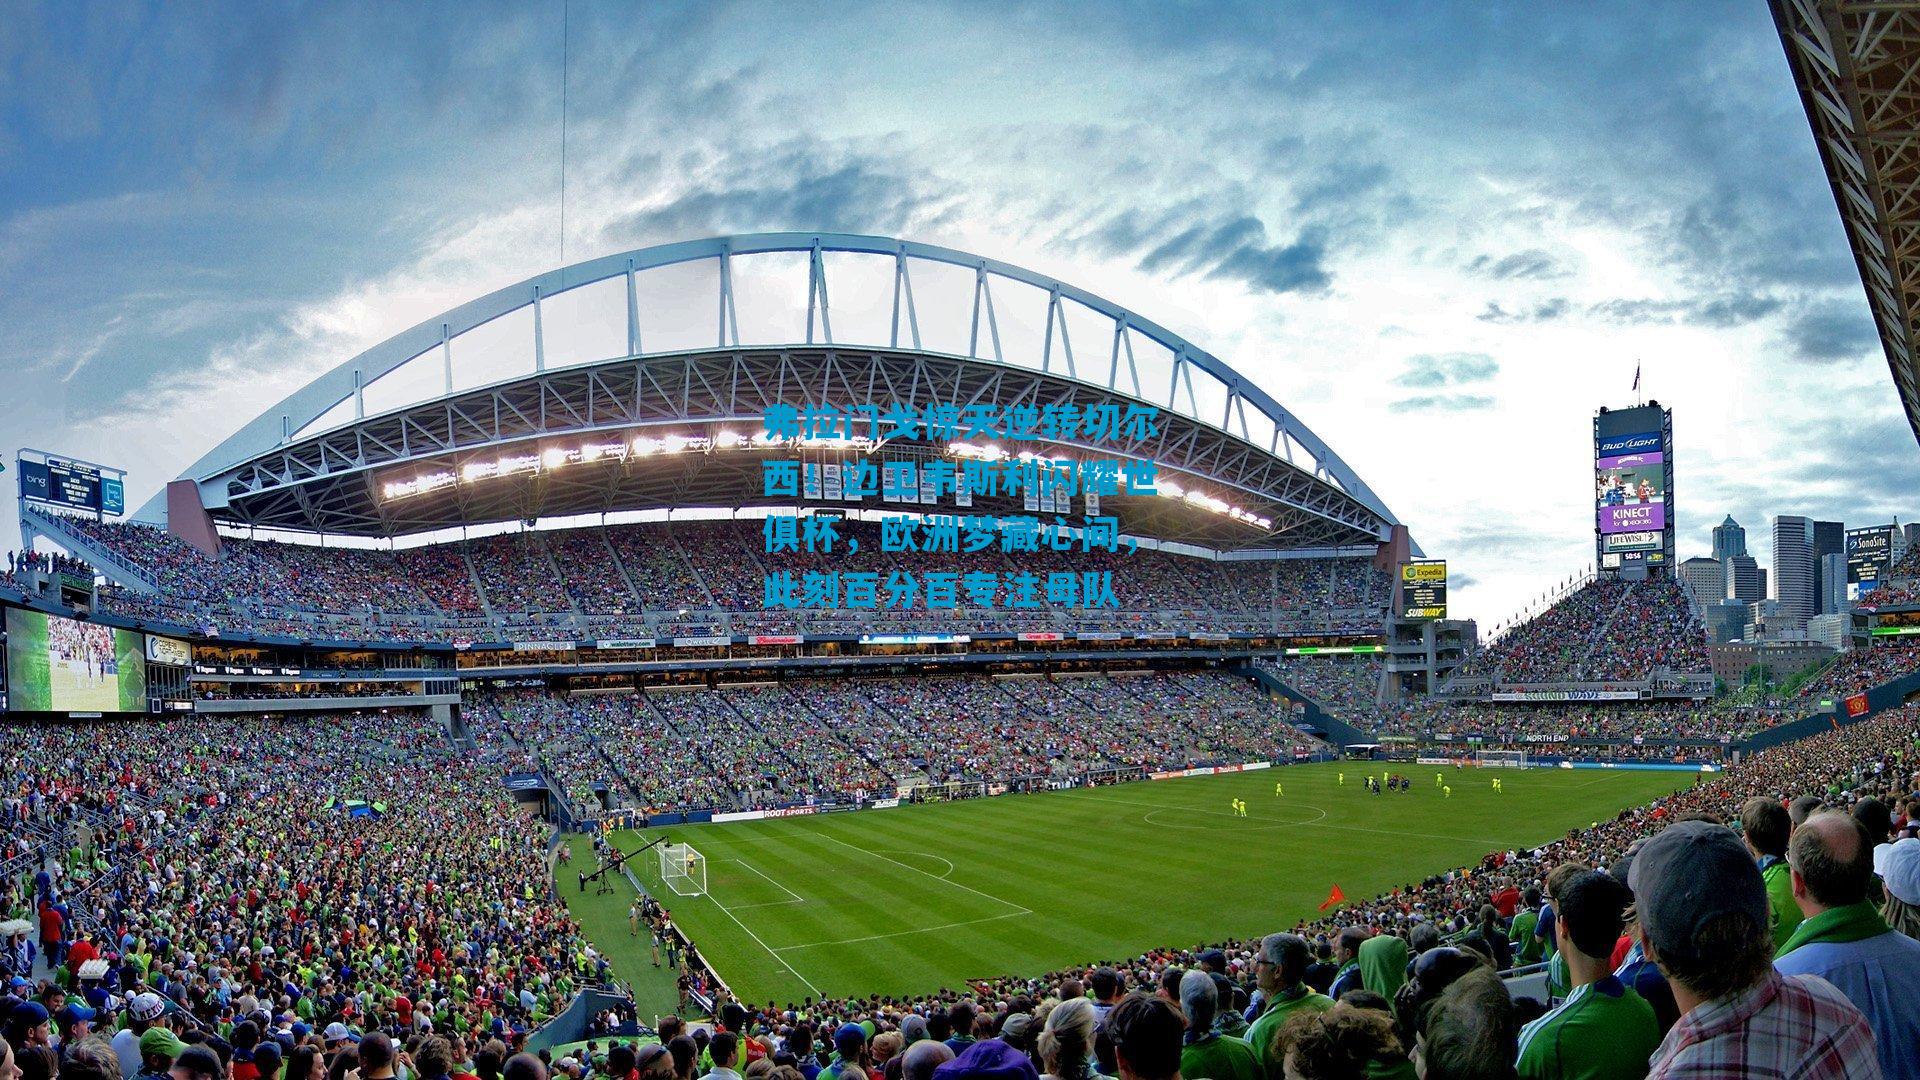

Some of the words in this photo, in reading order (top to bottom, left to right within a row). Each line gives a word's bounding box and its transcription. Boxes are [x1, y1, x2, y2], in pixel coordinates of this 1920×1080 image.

[1628, 439, 1658, 447] LIGHT
[26, 474, 46, 487] bing
[1613, 507, 1652, 519] KINECT
[1858, 536, 1887, 549] SonoSite
[1416, 569, 1442, 577] Expedia
[1405, 608, 1445, 618] SUBWAY
[685, 638, 709, 646] Qwest
[1526, 734, 1552, 742] NORTH
[1553, 734, 1570, 742] END
[764, 808, 785, 818] ROOT
[786, 807, 814, 816] SPORTS
